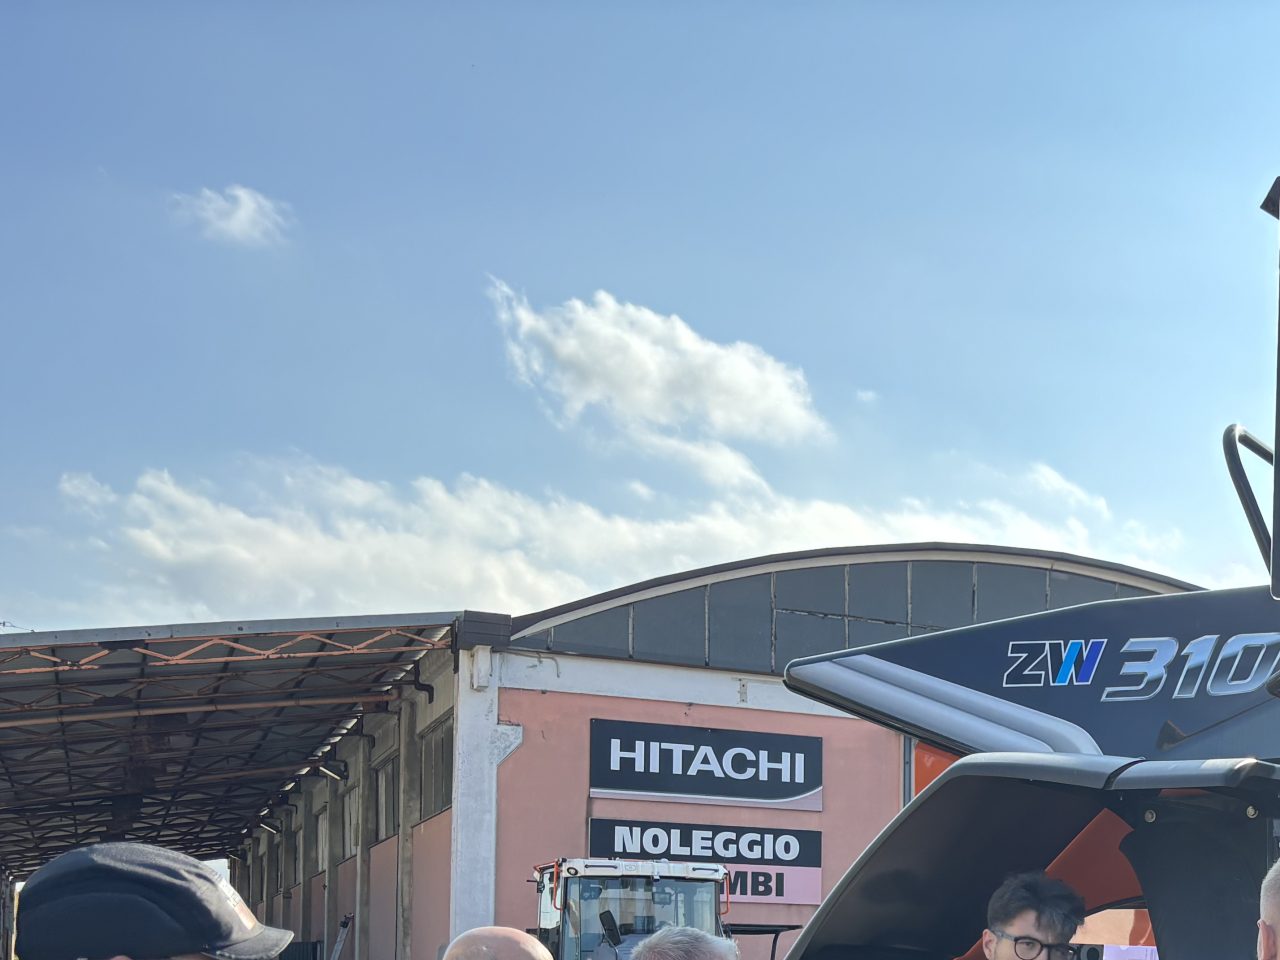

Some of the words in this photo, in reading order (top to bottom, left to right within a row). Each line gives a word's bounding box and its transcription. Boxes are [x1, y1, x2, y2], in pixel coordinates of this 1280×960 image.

[1003, 638, 1108, 688] ZW
[610, 738, 805, 784] HITACHI
[614, 825, 800, 861] NOLEGGIO
